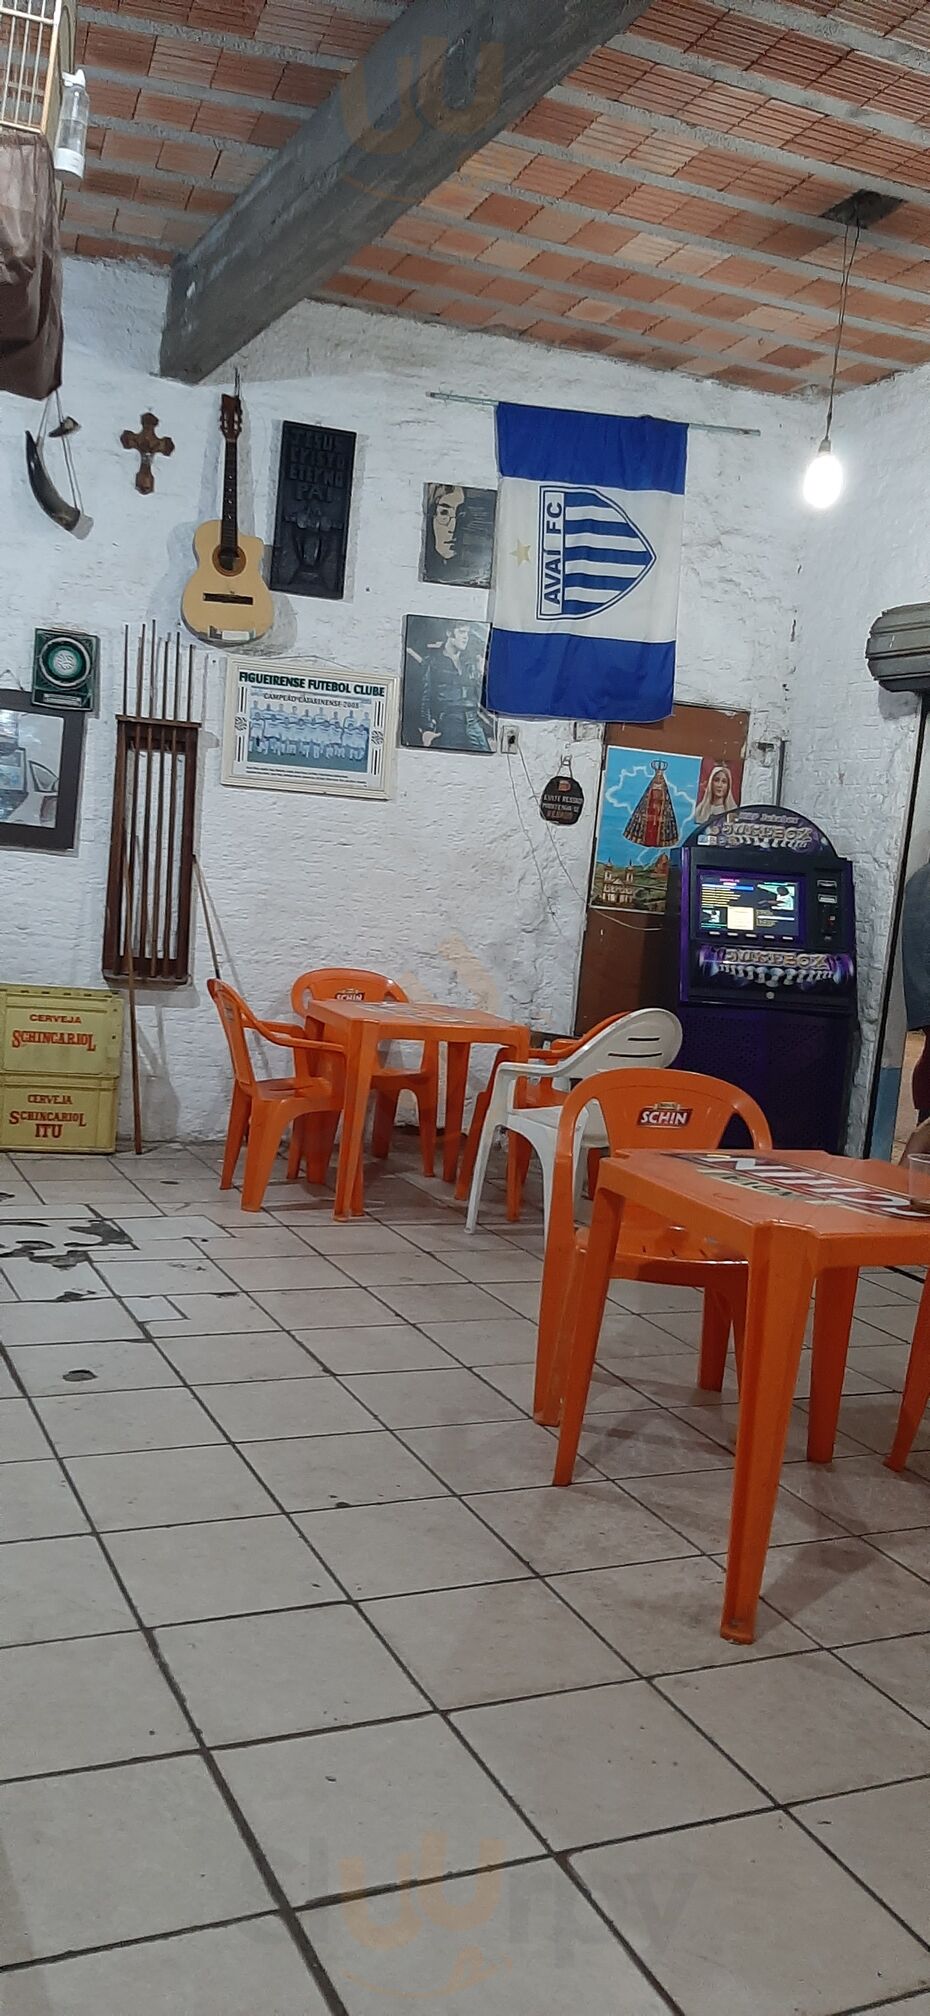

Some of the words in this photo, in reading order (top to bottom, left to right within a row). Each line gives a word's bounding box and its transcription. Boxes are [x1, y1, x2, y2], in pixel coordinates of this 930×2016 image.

[546, 502, 562, 534] FC
[238, 671, 306, 689] FIGUEIRENSE
[307, 677, 351, 694] FUTEBOL
[353, 684, 385, 697] CLUBE
[29, 1013, 82, 1024] CERVEJA
[12, 1030, 97, 1052] SCHINCARIOL
[27, 1094, 73, 1105] CERVEJA
[9, 1110, 87, 1127] SCHINCARIOL
[640, 1110, 688, 1125] SCHIN
[35, 1123, 63, 1138] ITU
